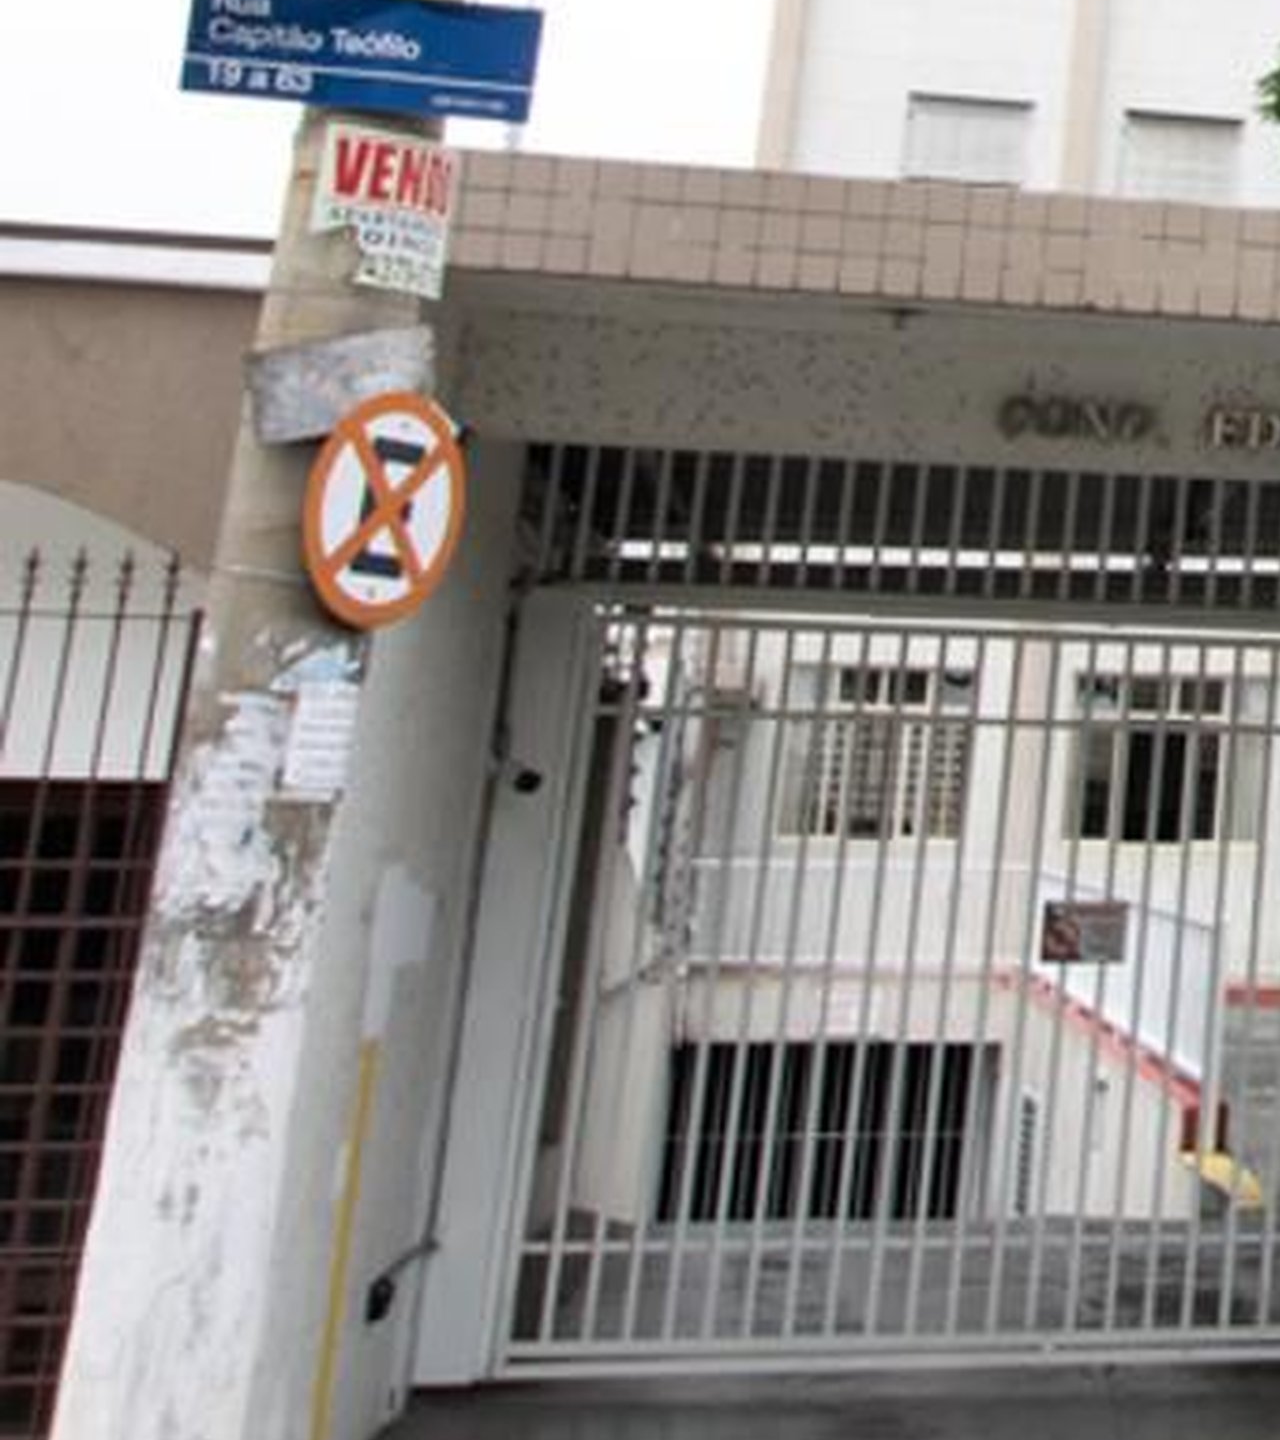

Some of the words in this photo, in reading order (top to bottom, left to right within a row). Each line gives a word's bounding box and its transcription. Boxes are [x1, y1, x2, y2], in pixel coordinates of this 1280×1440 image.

[207, 16, 323, 53] Capitão
[330, 27, 421, 61] Teófilo
[207, 58, 242, 88] 19
